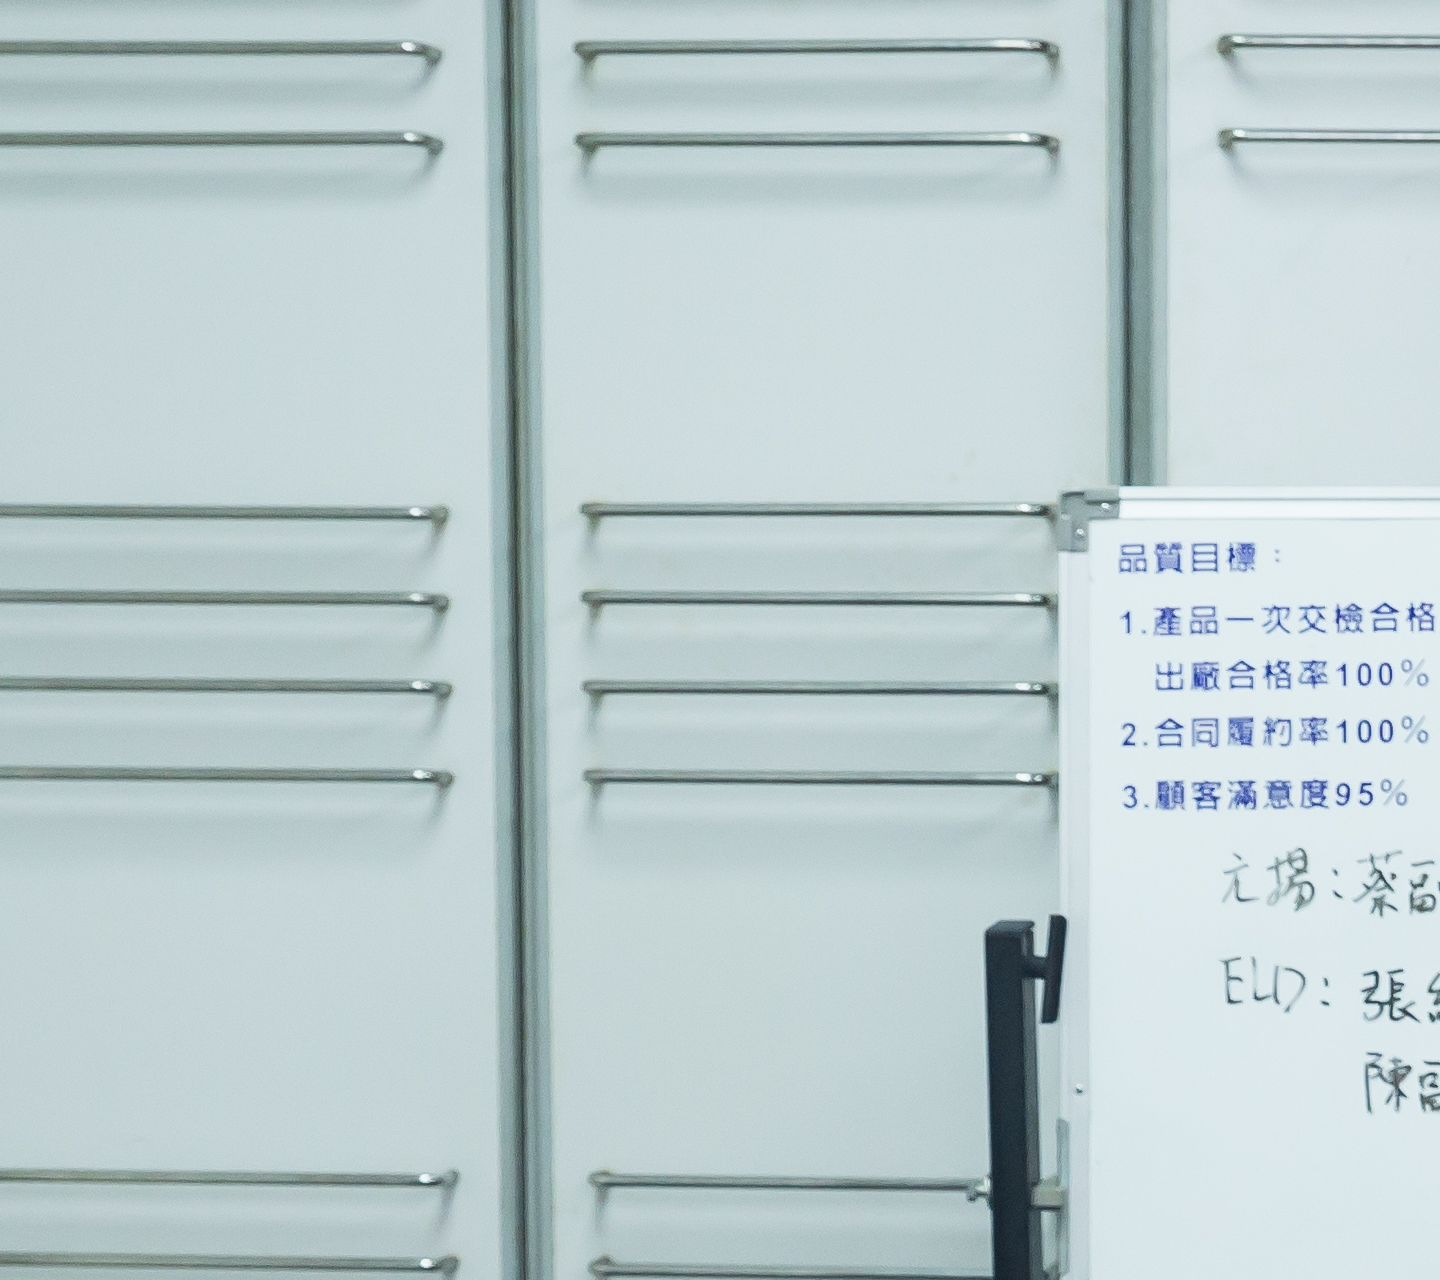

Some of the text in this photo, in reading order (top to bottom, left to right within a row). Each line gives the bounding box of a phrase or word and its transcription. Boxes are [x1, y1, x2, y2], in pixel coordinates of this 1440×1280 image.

[1119, 542, 1279, 574] 品質目標:
[1155, 659, 1429, 692] 出廠合格率100%
